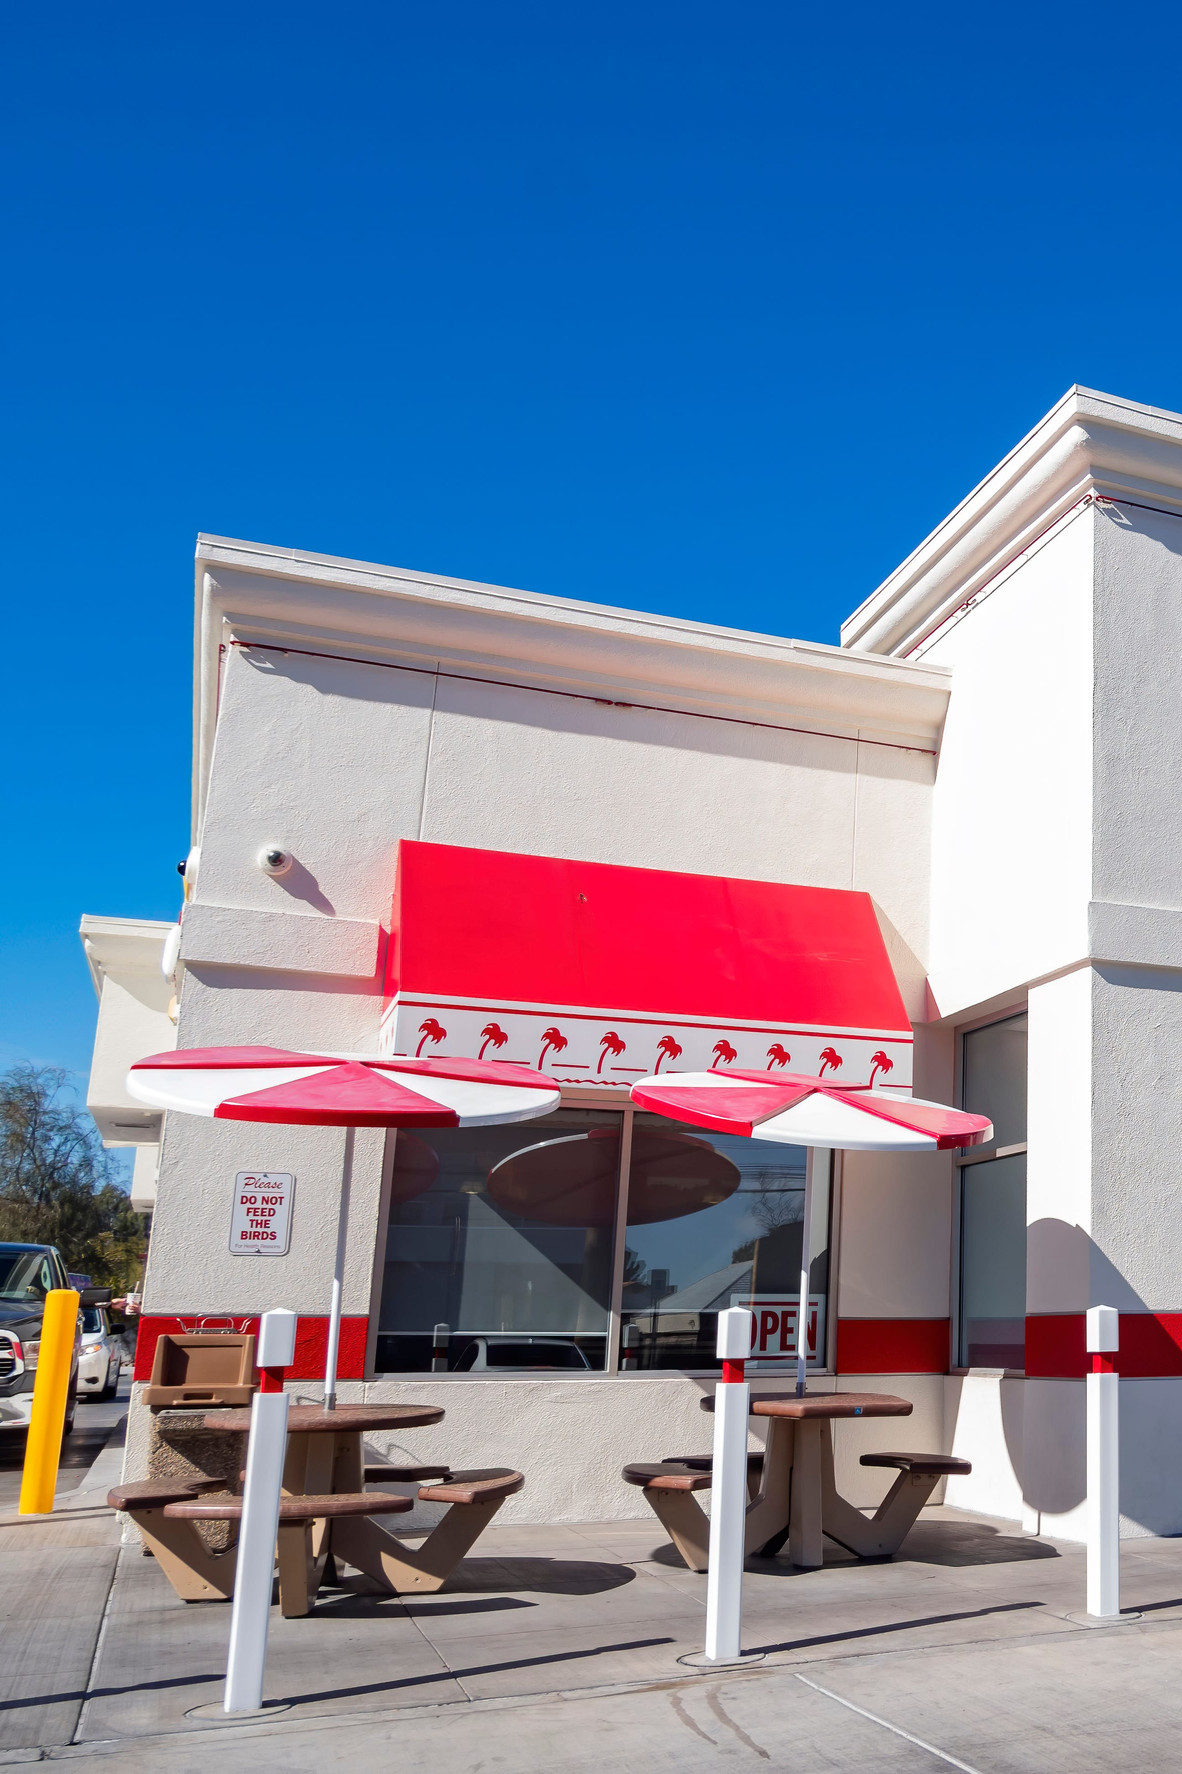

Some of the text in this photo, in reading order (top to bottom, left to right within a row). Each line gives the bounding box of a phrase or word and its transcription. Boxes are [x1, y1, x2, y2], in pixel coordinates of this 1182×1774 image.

[243, 1176, 283, 1189] Please
[240, 1195, 285, 1205] DO NOT
[246, 1207, 276, 1217] FEED
[249, 1219, 271, 1229] THE
[240, 1231, 277, 1241] BIRDS
